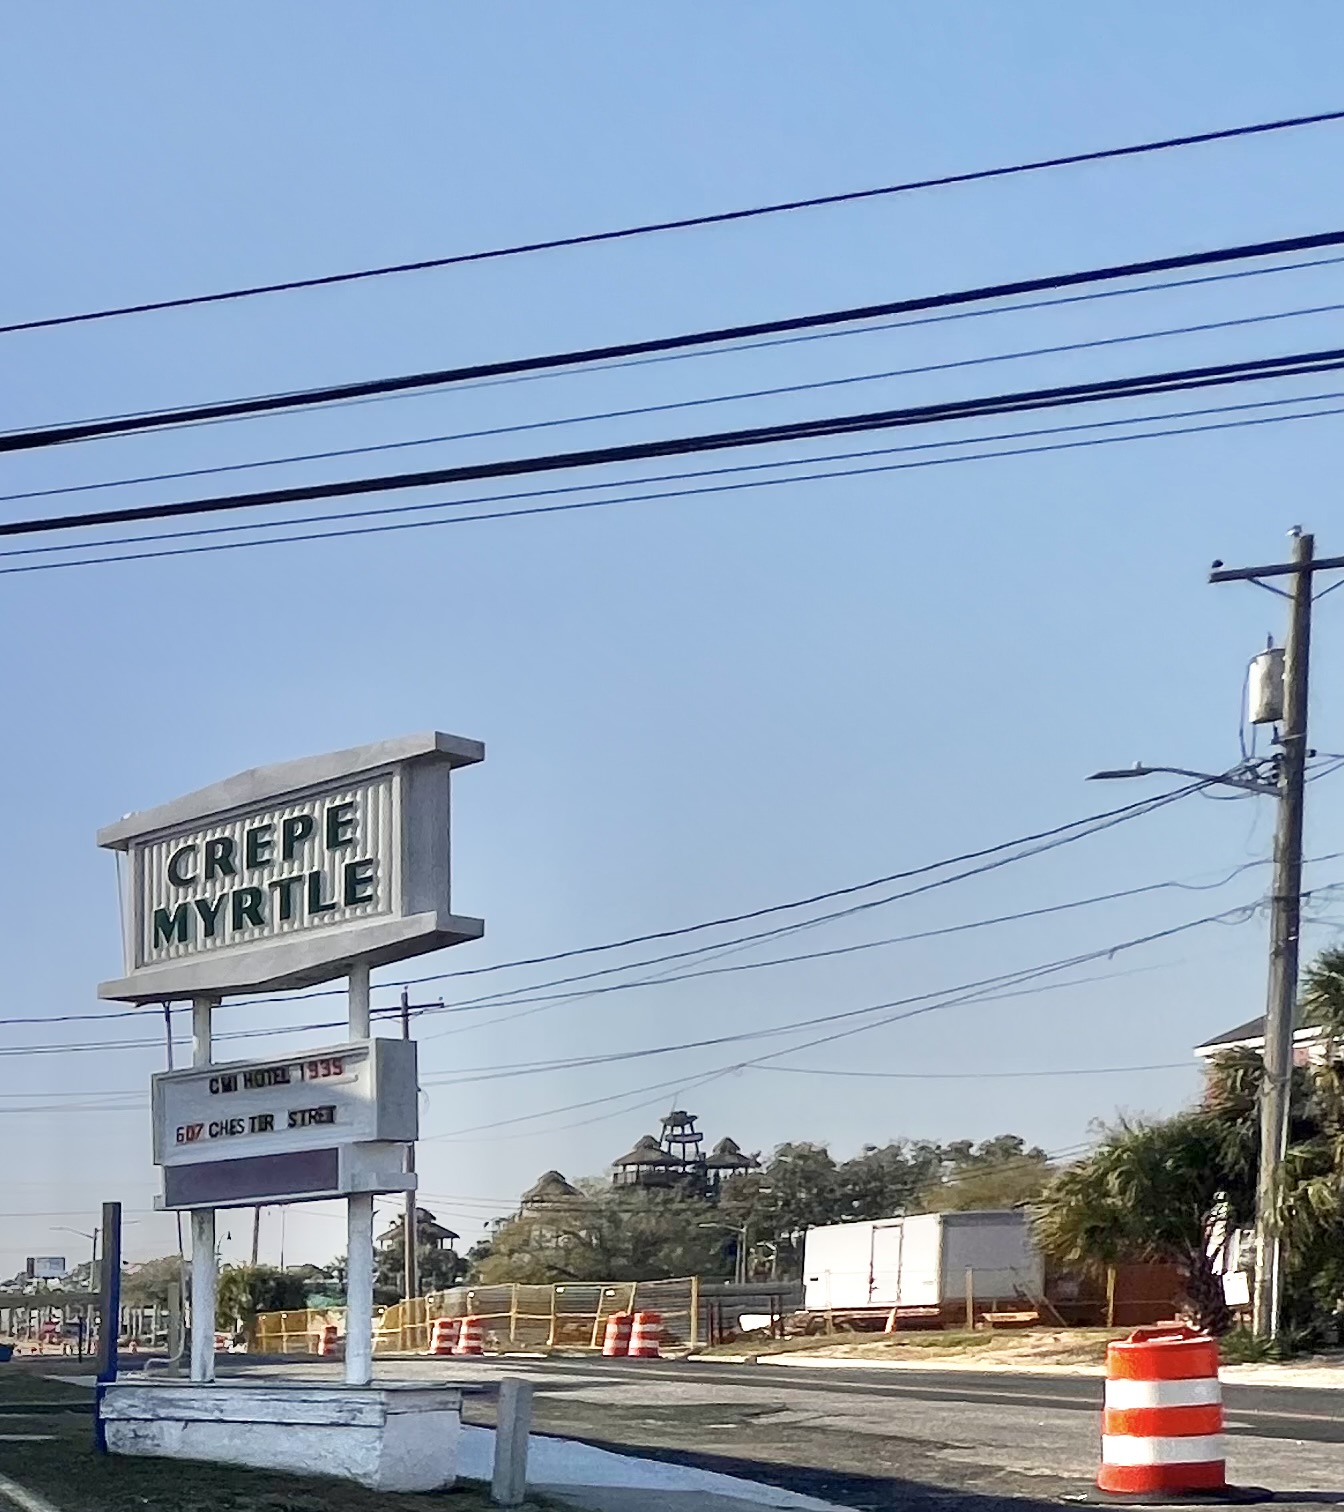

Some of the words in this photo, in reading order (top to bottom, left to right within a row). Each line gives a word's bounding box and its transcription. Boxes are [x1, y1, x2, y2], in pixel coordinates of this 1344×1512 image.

[167, 801, 355, 887] CREPE
[153, 858, 374, 949] MYRTLE
[243, 1066, 290, 1089] HOTEL
[176, 1123, 204, 1143] 607
